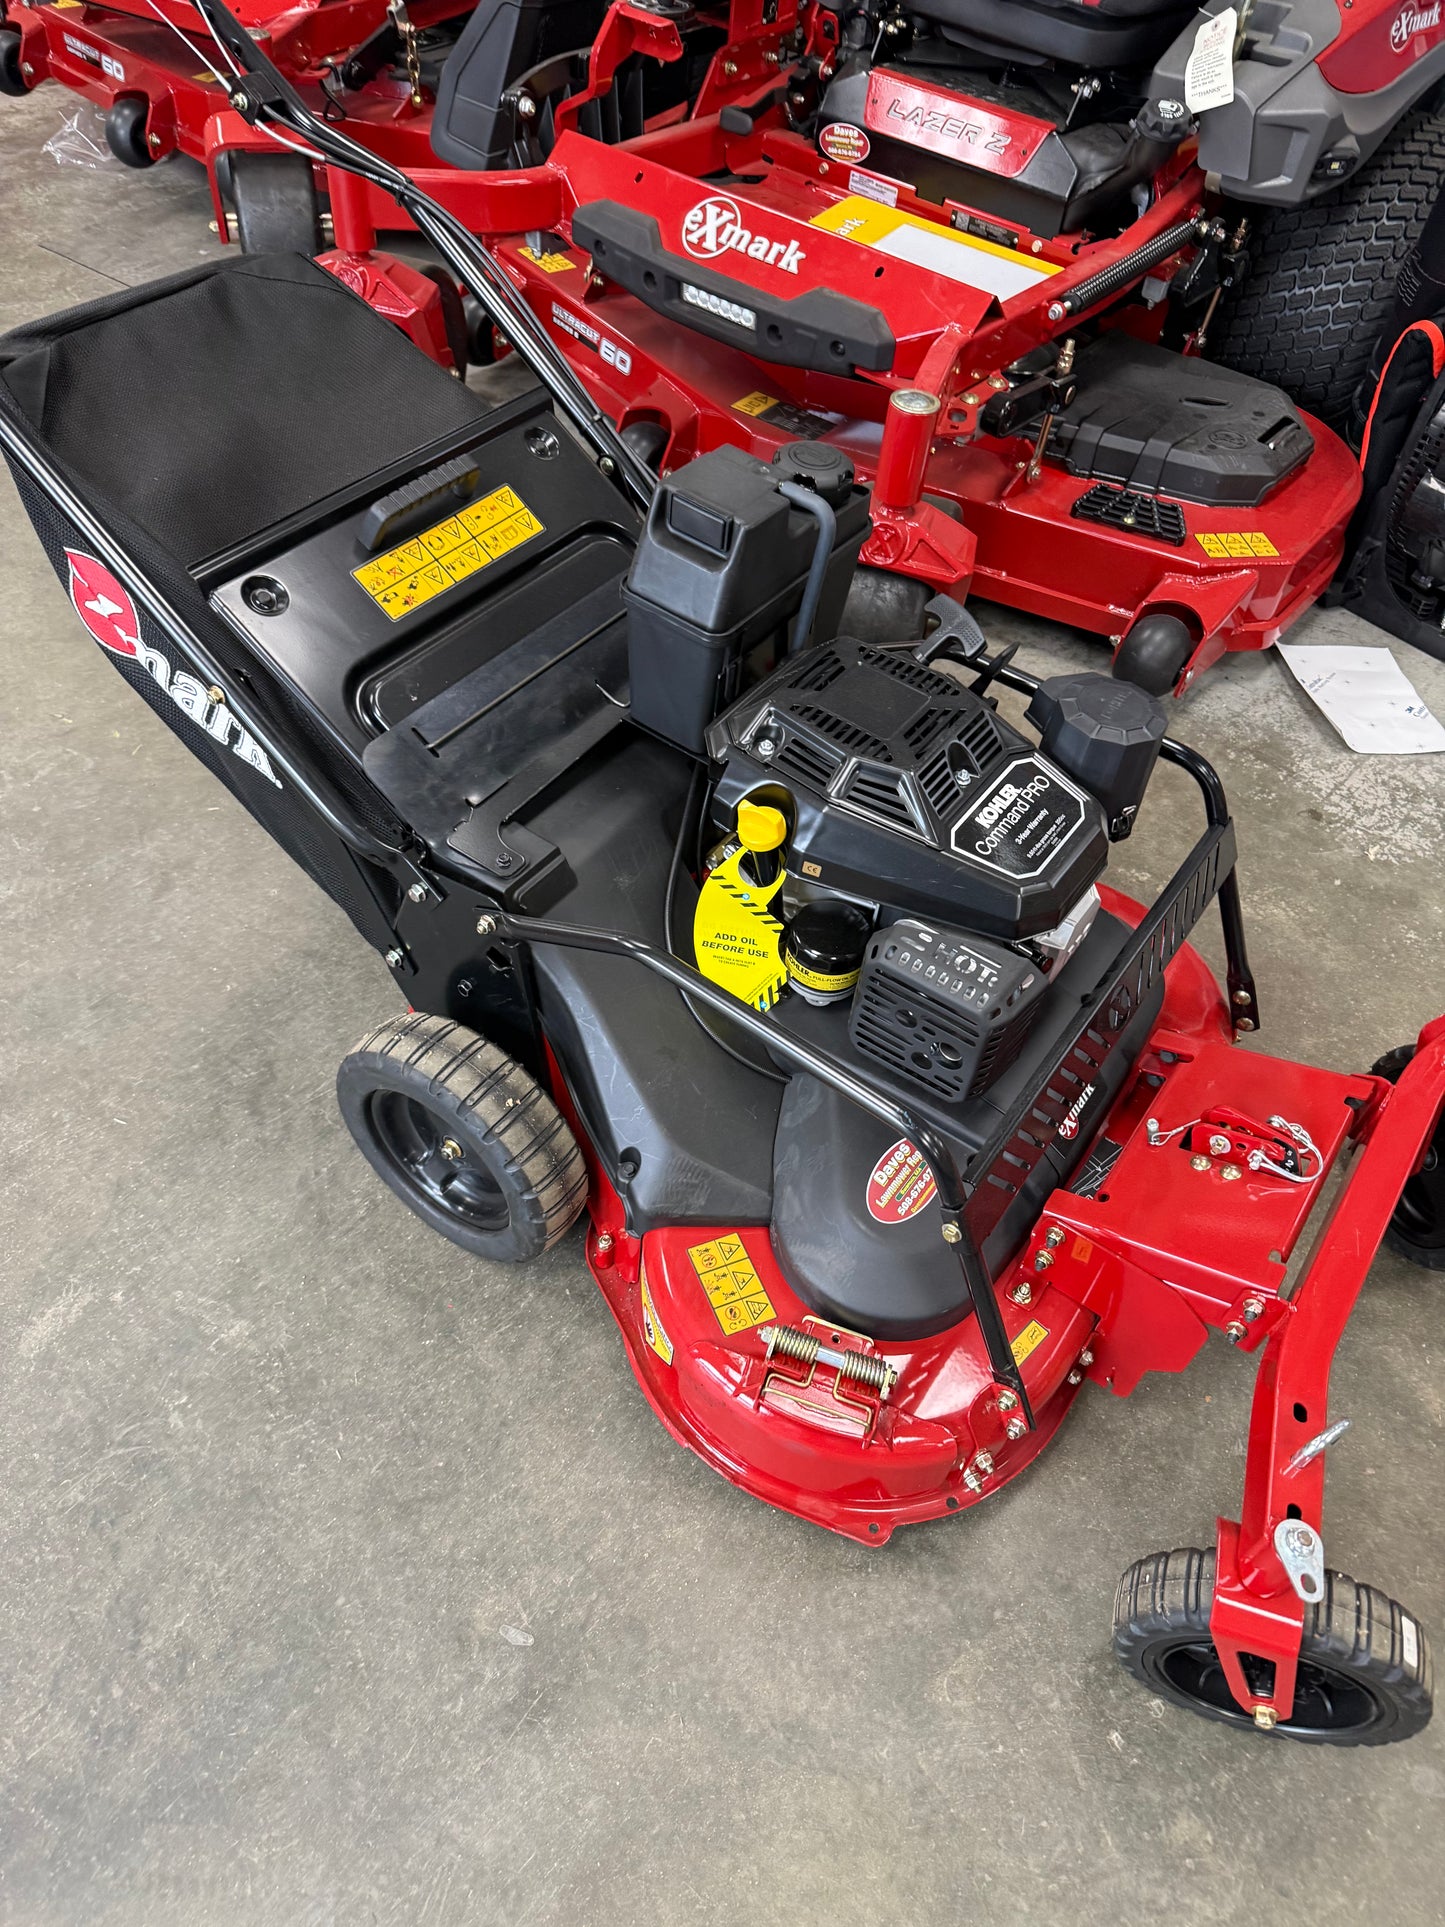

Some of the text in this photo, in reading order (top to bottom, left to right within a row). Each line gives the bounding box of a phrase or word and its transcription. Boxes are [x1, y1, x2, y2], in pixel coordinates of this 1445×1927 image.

[101, 53, 125, 82] 60
[886, 98, 1012, 156] LAZER Z
[682, 197, 807, 275] eXmark
[599, 337, 632, 377] 60
[975, 783, 1023, 830] KOHLER
[975, 797, 1031, 856] Command
[1020, 775, 1051, 803] PRO
[1015, 808, 1049, 845] 3-Year Warranty
[701, 940, 769, 959] BEFORE USE
[714, 932, 758, 946] ADD OIL
[933, 942, 998, 983] HOT
[1058, 1083, 1096, 1139] eXmark
[873, 1143, 911, 1186] Daves
[875, 1164, 911, 1208] Lawnmower
[897, 1167, 933, 1216] 508-676-07
